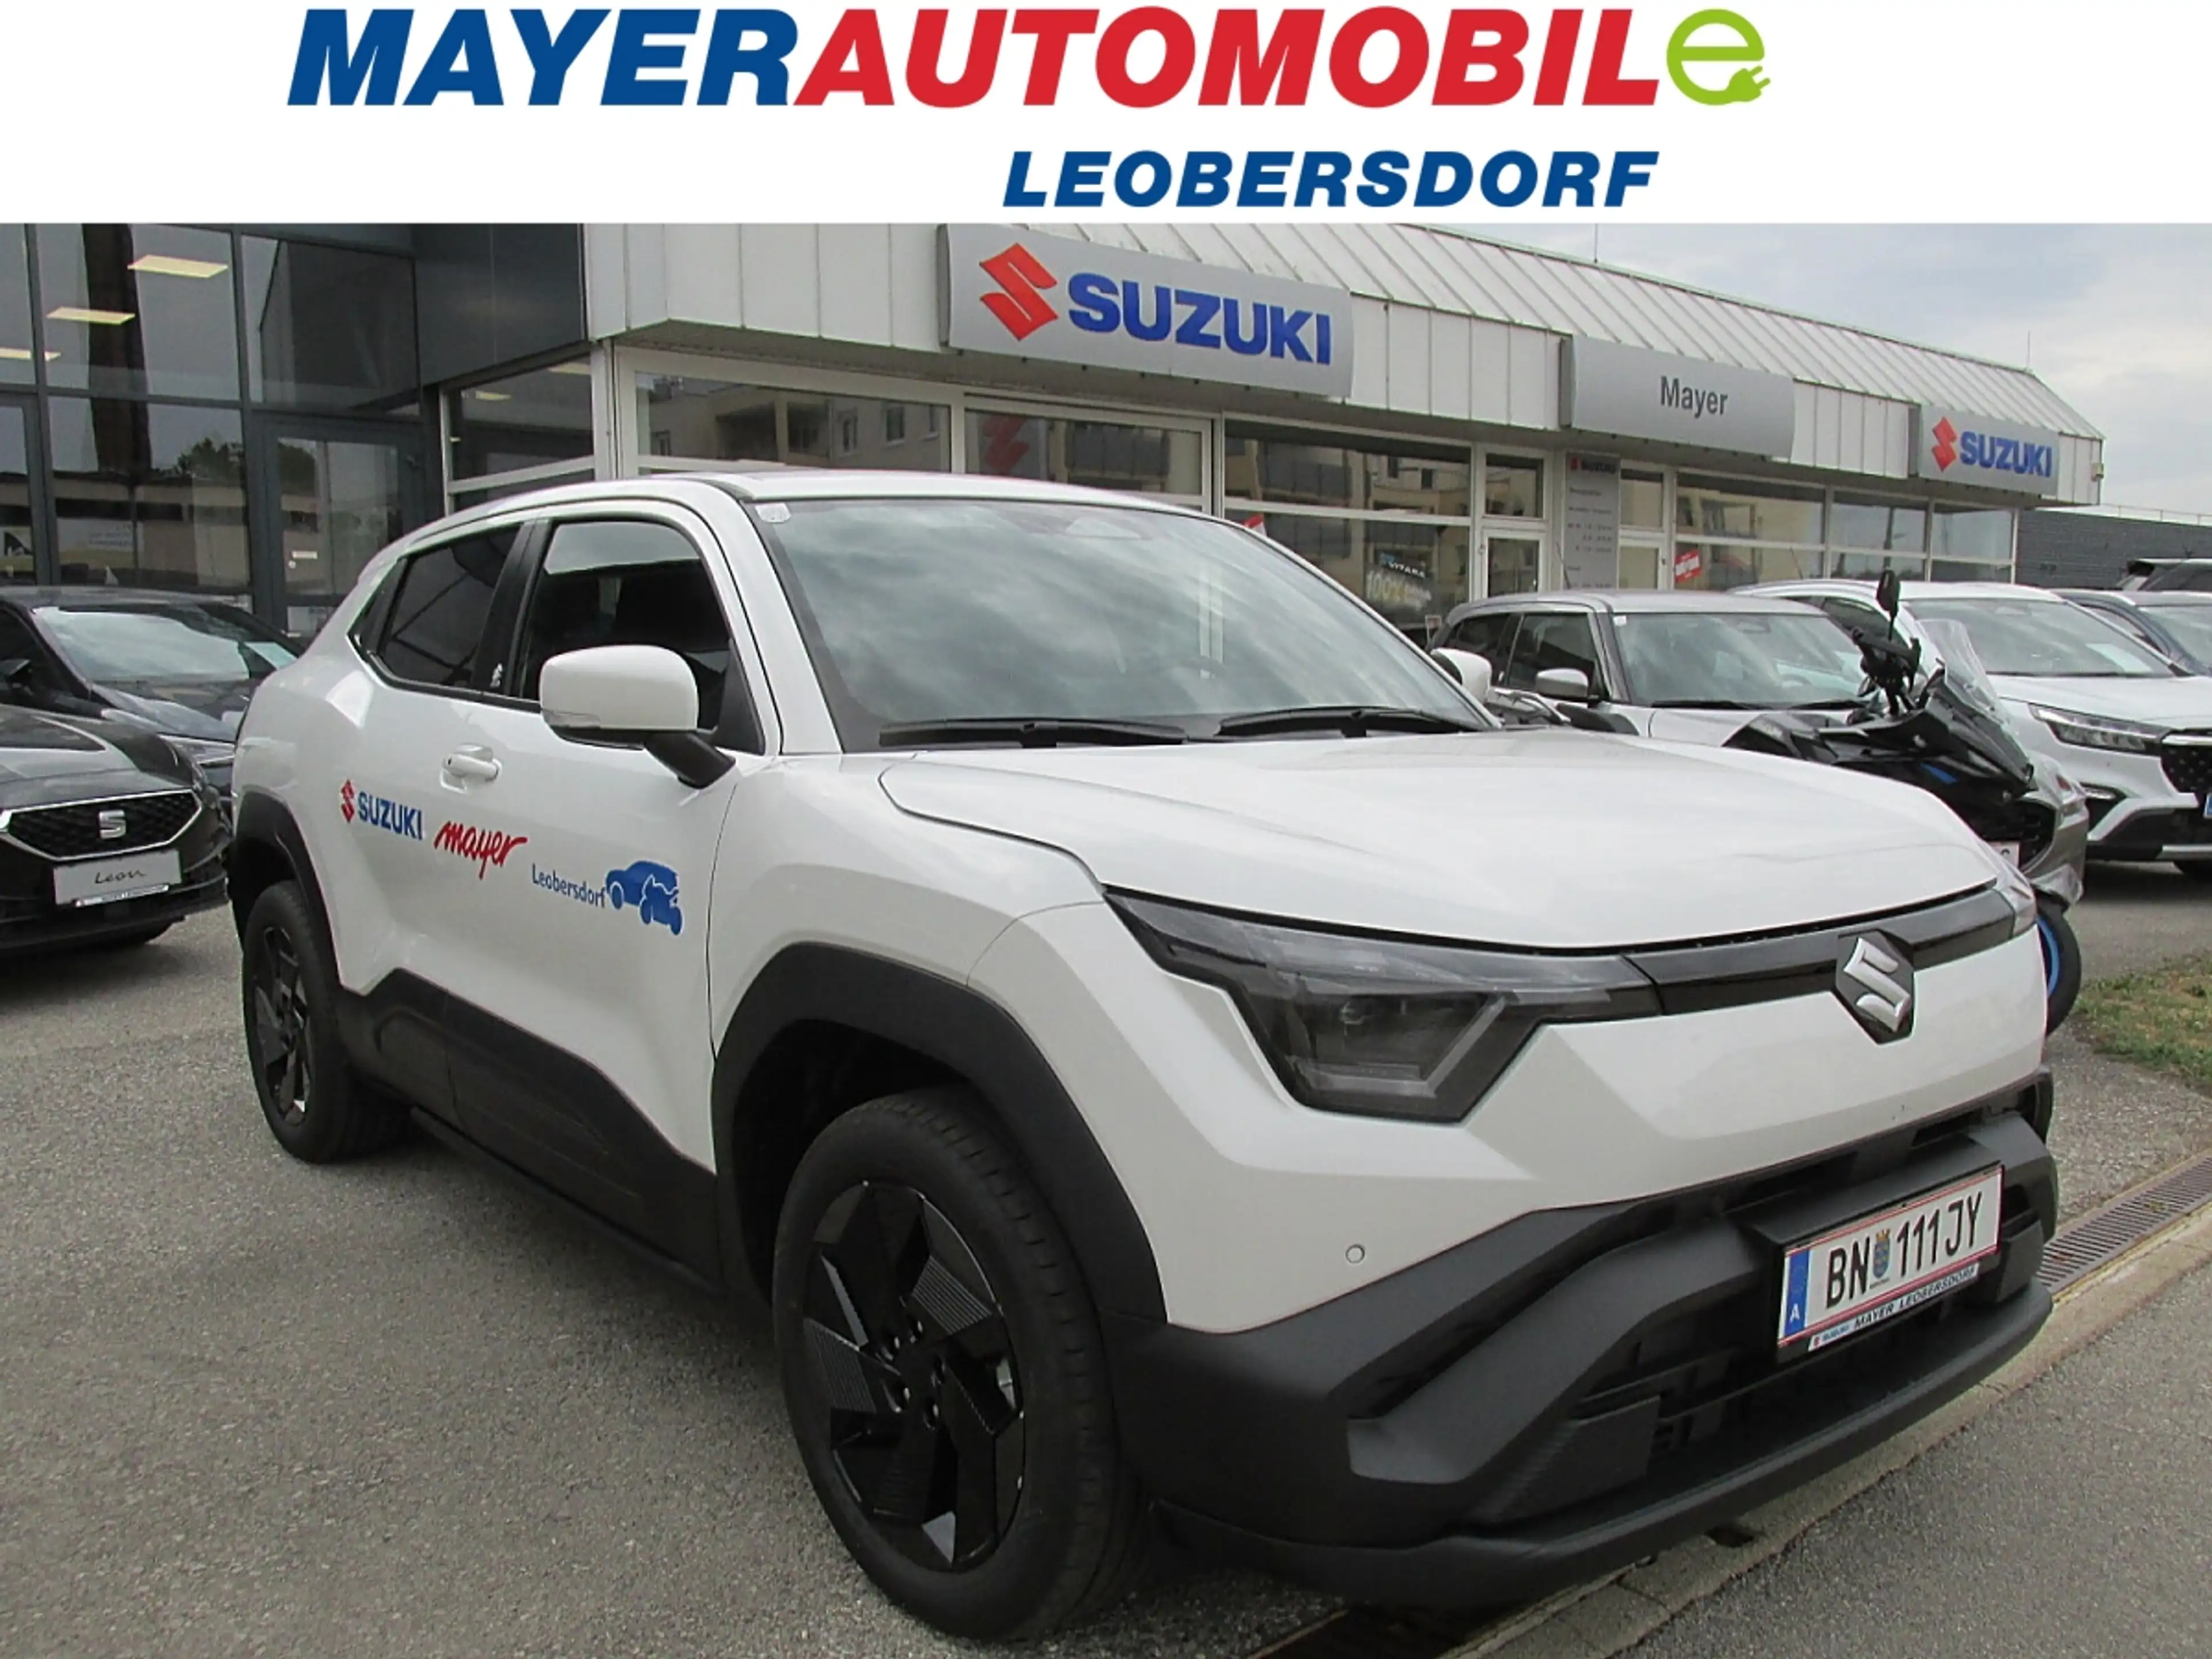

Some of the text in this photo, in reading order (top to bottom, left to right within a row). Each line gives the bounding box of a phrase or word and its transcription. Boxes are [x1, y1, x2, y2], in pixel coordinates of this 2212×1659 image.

[1069, 272, 1333, 365] SUZUKI
[1660, 376, 1729, 421] Mayer
[1960, 430, 2054, 479] SUZUKI
[357, 791, 423, 840] SUZUKI
[433, 820, 528, 880] mayer
[94, 869, 147, 884] Leon
[532, 864, 606, 908] Leobersdorf
[1826, 1236, 1870, 1309] BN
[1789, 1302, 1800, 1324] A
[1854, 1302, 1895, 1329] MAYER
